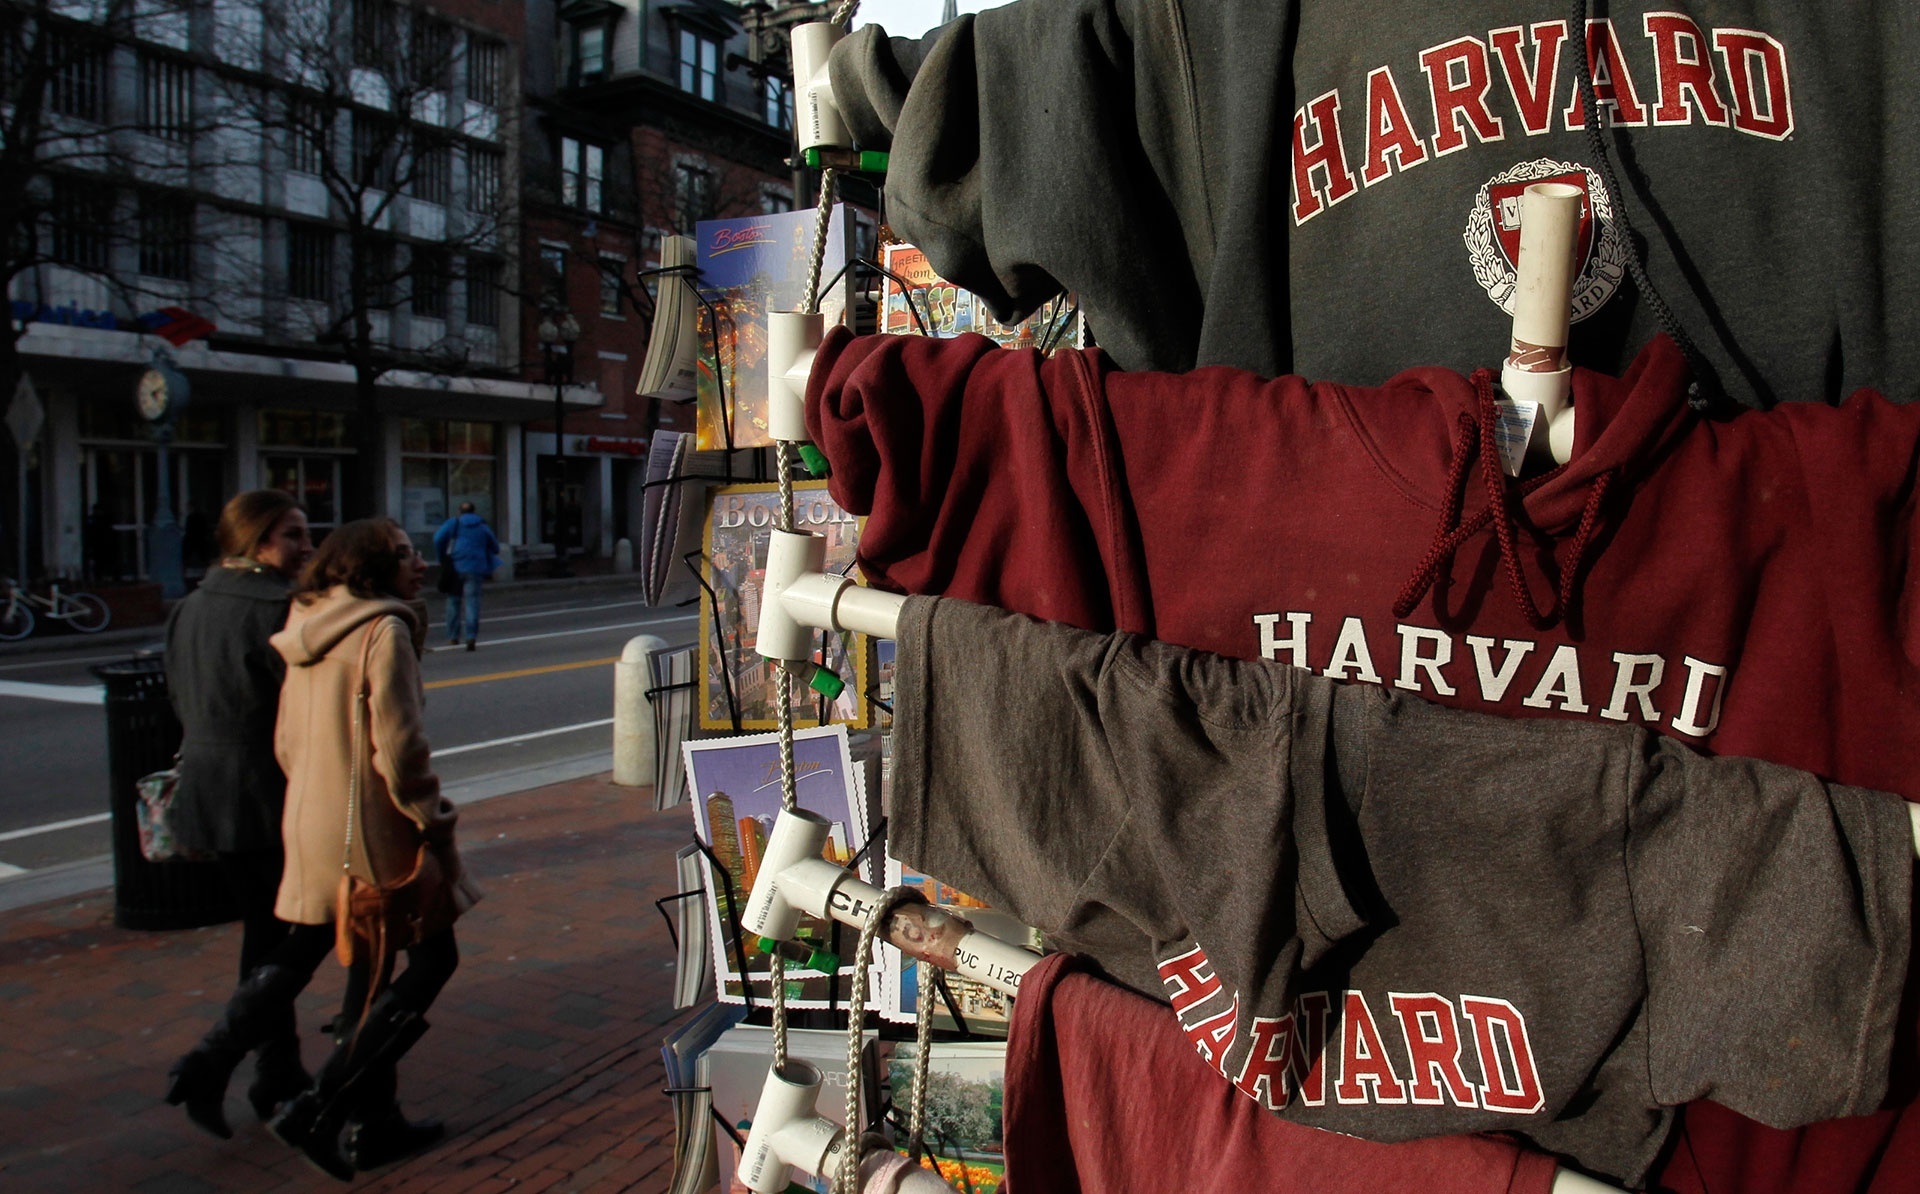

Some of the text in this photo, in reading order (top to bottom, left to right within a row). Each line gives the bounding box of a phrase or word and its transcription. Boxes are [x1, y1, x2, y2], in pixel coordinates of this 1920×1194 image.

[1292, 11, 1795, 226] HARVARD
[710, 225, 772, 250] Boston
[1253, 610, 1728, 738] HARVARD
[1156, 942, 1546, 1115] HARVARD
